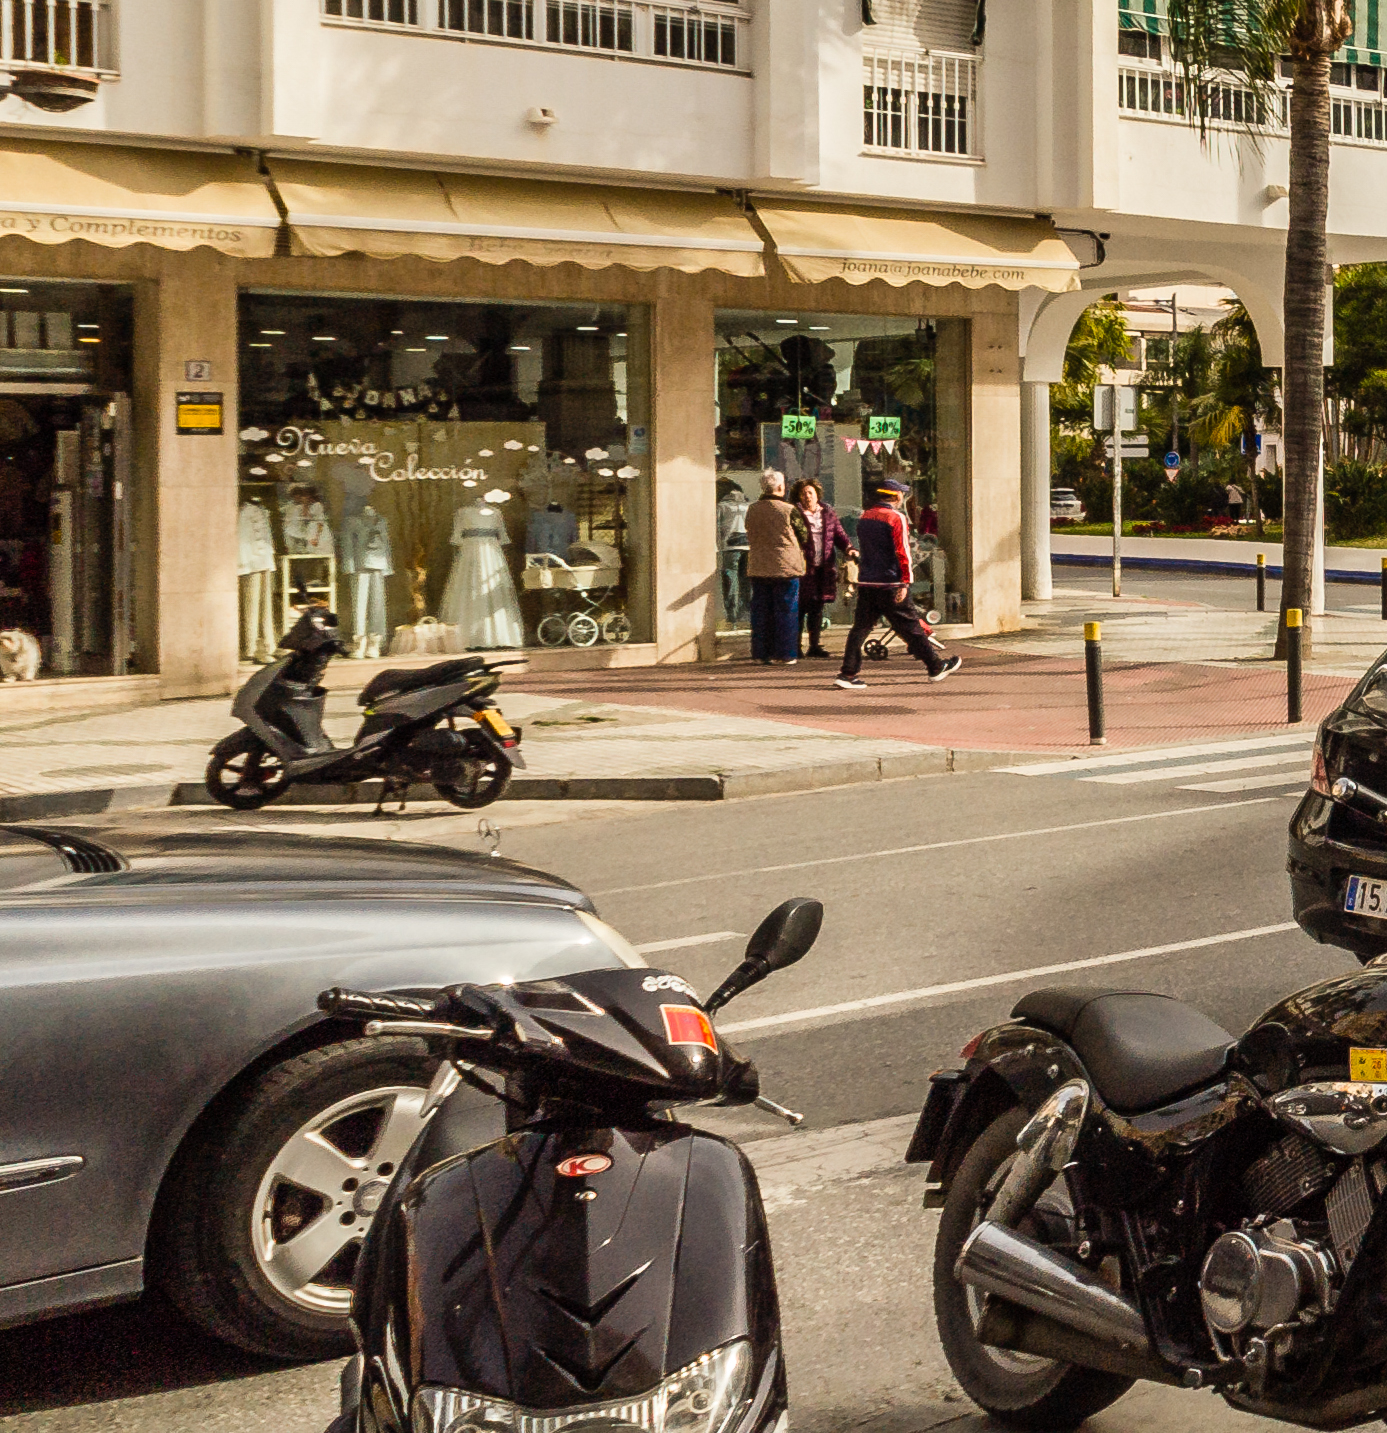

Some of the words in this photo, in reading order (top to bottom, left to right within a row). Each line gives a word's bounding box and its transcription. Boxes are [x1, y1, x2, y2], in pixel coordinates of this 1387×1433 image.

[50, 216, 242, 242] Complementos
[277, 426, 378, 456] Nueva
[369, 451, 488, 482] Colección
